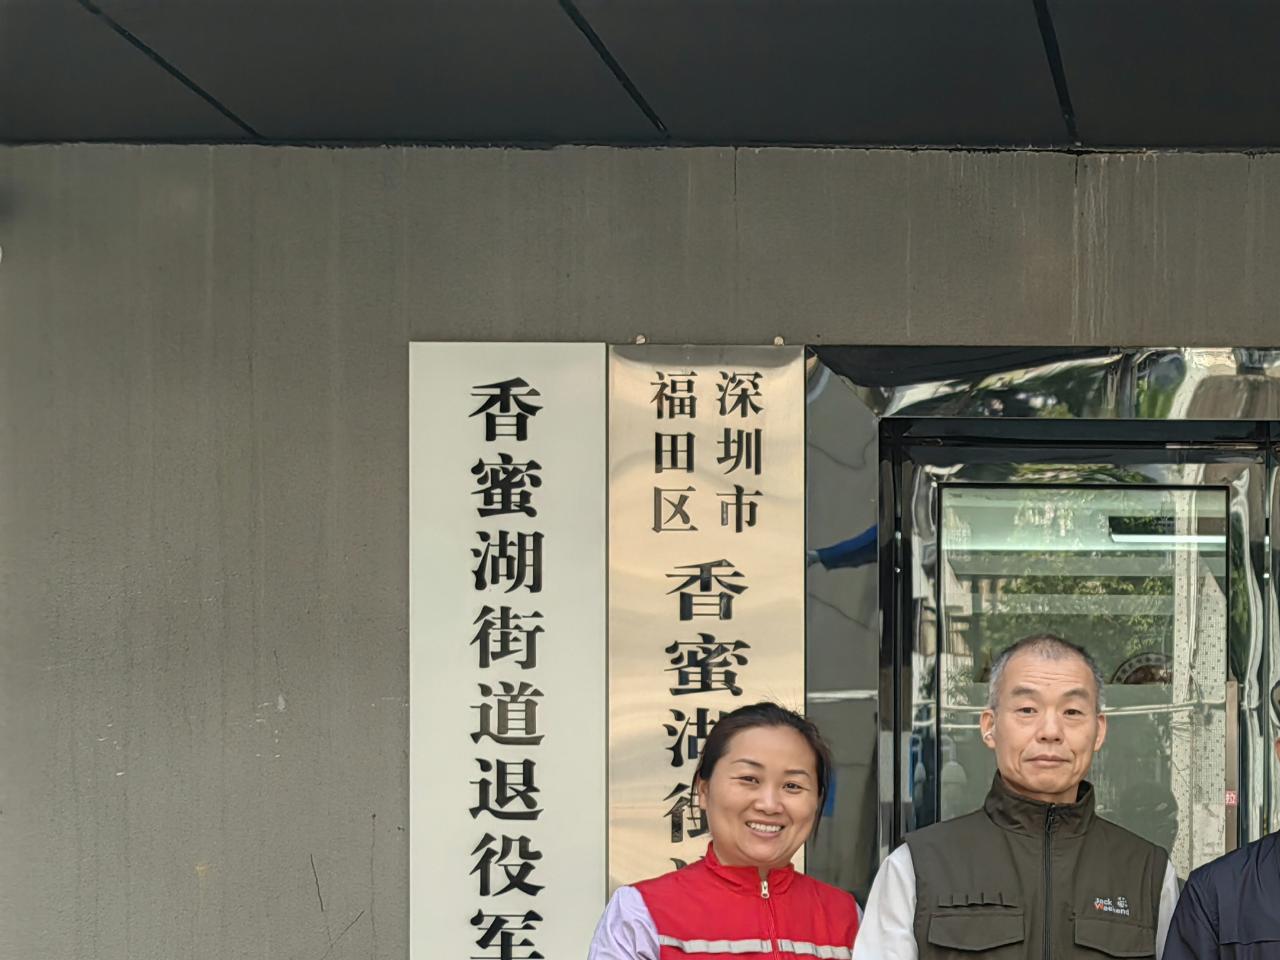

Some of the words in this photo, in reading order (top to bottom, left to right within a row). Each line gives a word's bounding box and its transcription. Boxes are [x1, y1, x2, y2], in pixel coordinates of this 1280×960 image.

[651, 371, 699, 533] 福田区
[716, 371, 763, 533] 深圳市
[663, 559, 751, 869] 香蜜湖街
